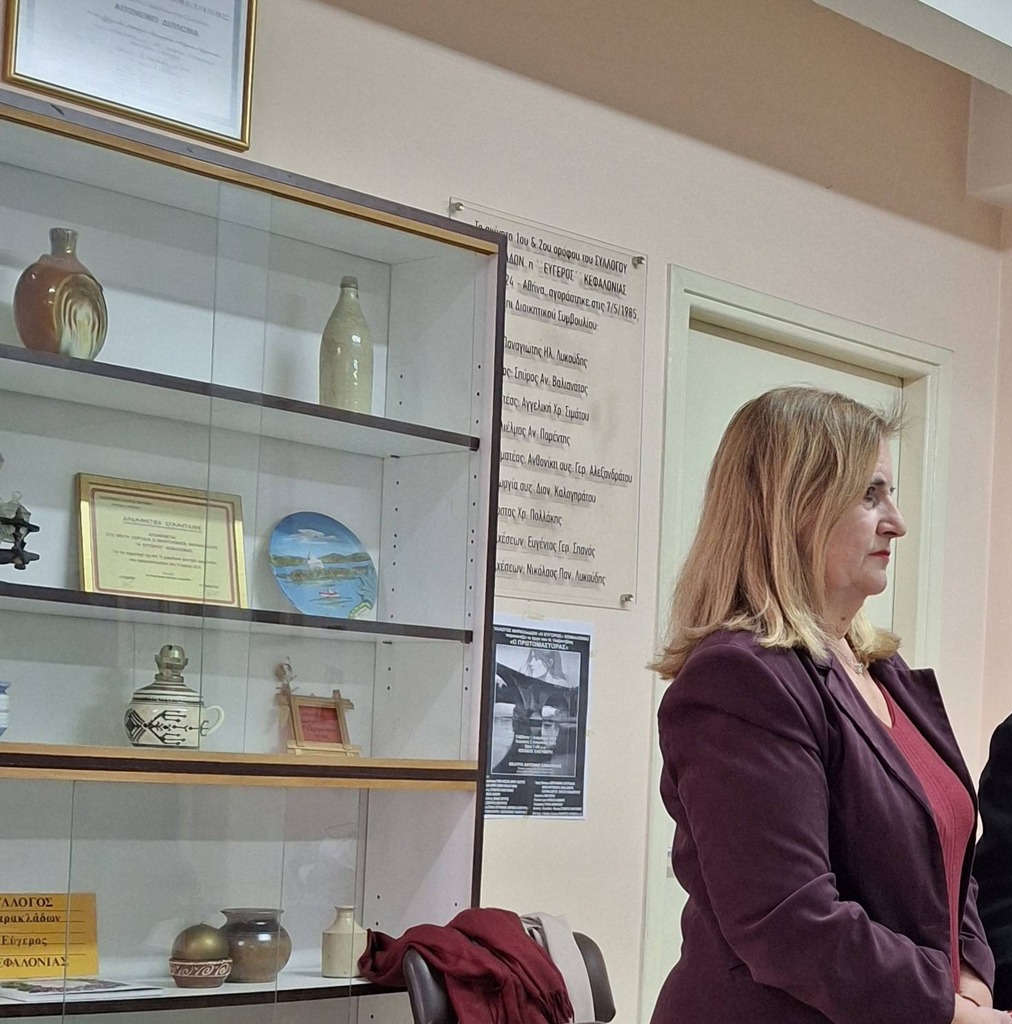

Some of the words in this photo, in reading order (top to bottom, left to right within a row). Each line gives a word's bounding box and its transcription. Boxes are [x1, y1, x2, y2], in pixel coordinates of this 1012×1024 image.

[530, 236, 537, 248] &
[538, 238, 552, 253] 2ου
[595, 254, 628, 274] ΣΥΛΛΟΓΟΥ
[584, 273, 627, 296] ΚΕΦΑΛΟΝΙΑΣ
[515, 299, 556, 320] Διοικητικού
[548, 288, 590, 307] αγοράστηκε
[591, 300, 606, 313] στις
[556, 349, 589, 369] Λυκούδης
[514, 366, 540, 386] Σπύρος
[522, 396, 552, 414] Αγγελική
[565, 405, 590, 422] Σιμάτου
[540, 427, 571, 447] Παρέντης
[590, 464, 633, 483] Αλεξανδράτου
[528, 536, 557, 553] Ευγένιος
[526, 563, 558, 580] Νικόλαος
[575, 569, 606, 586] Λυκούδης
